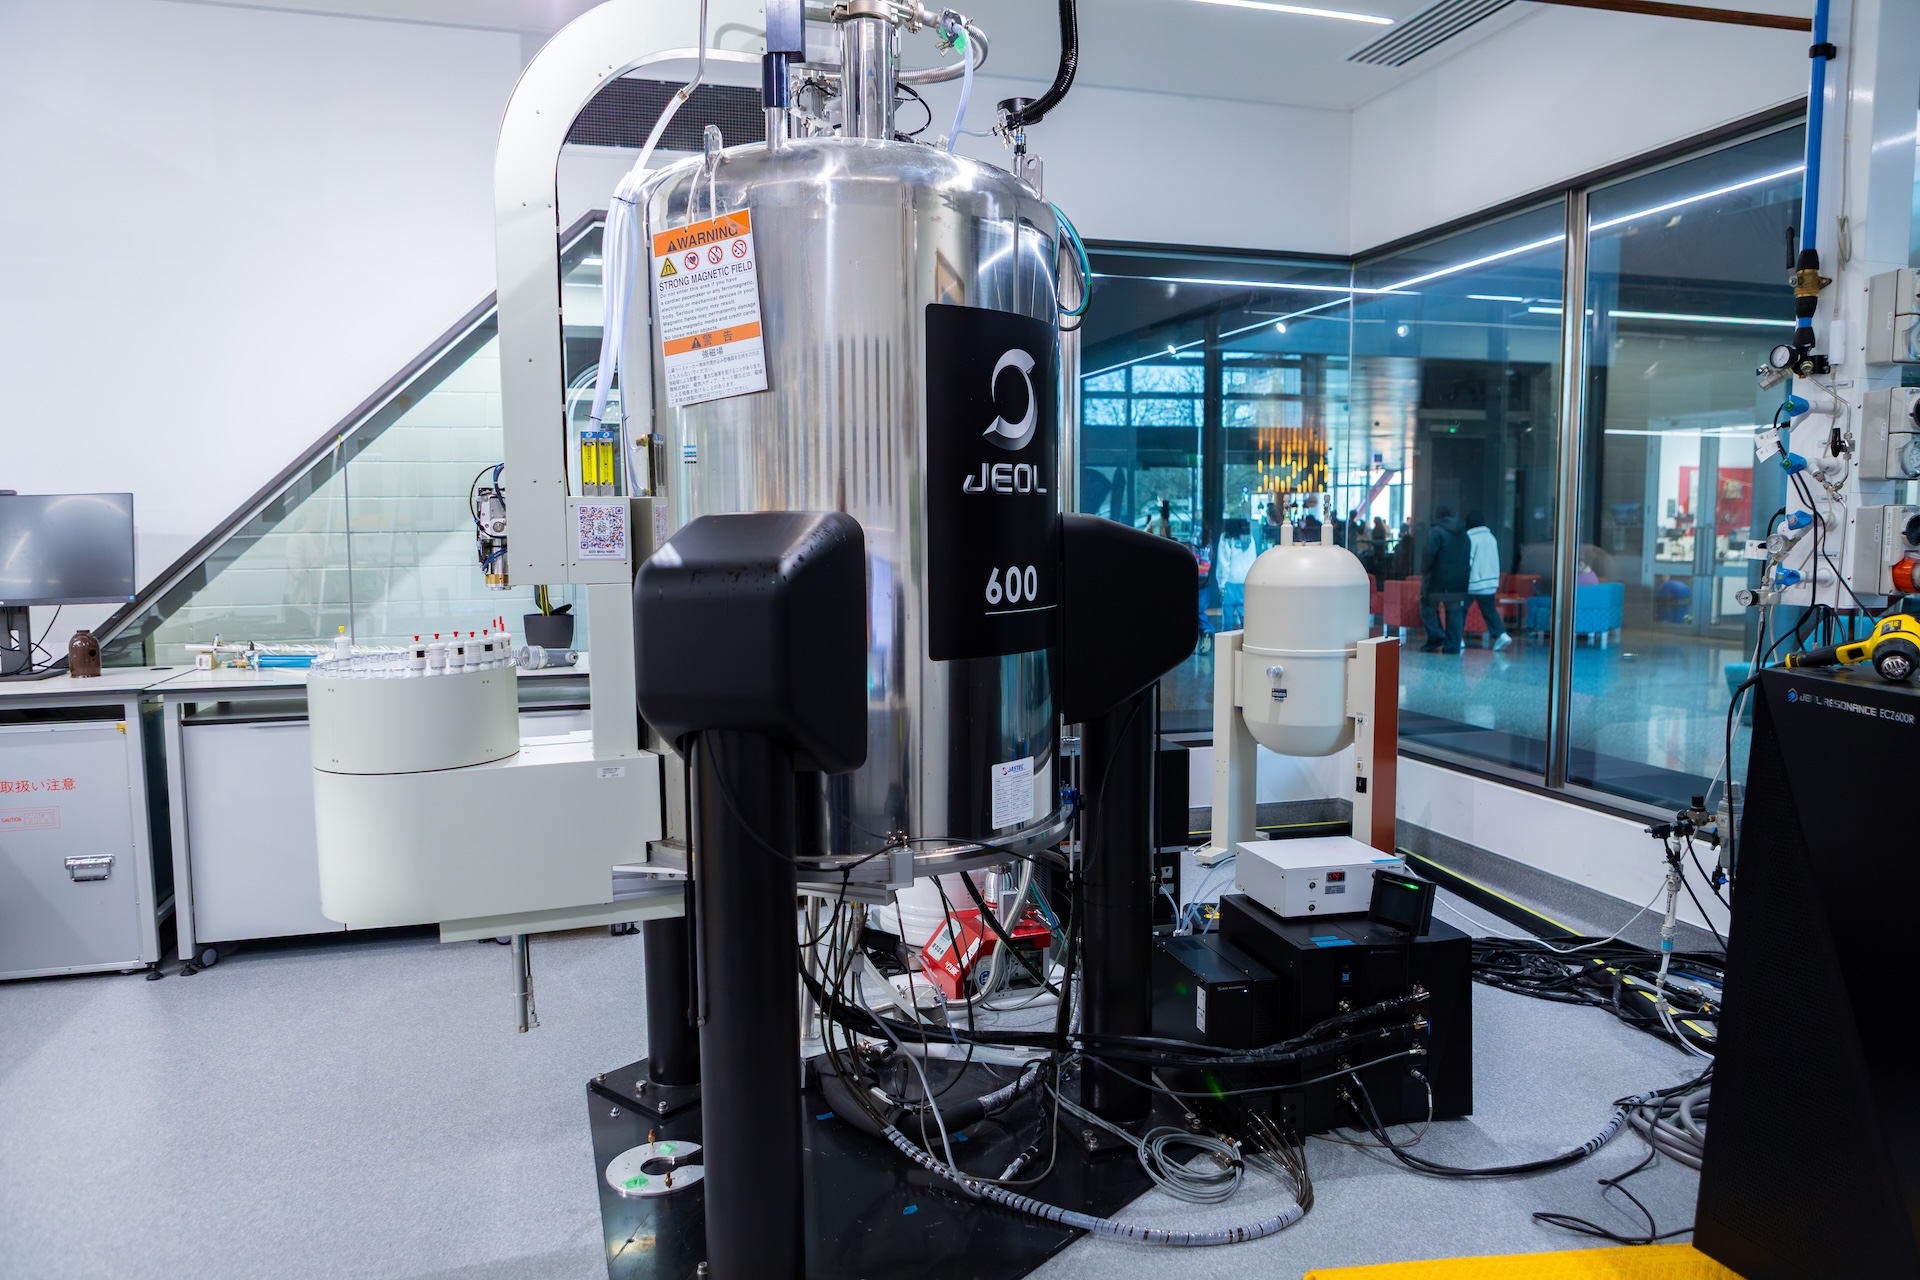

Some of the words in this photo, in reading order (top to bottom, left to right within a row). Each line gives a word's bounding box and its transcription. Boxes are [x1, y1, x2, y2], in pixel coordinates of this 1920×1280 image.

[677, 224, 738, 250] WARNING
[659, 277, 689, 291] STRONG
[692, 266, 729, 284] MAGNETIC
[732, 260, 752, 274] FIELD
[681, 291, 705, 301] pacemaker
[691, 295, 717, 305] mechanical
[718, 291, 736, 299] devices
[662, 318, 683, 327] Magnetic
[708, 305, 736, 317] permanently
[737, 301, 756, 310] damage
[675, 308, 693, 316] Serious
[694, 305, 708, 313] injury
[700, 325, 717, 334] objects.
[701, 346, 723, 358] 強磁場
[963, 463, 1047, 495] JEOL
[985, 565, 1038, 604] 600
[1799, 693, 1822, 705] JEL
[1823, 698, 1877, 716] RESONANCE
[1880, 708, 1915, 724] ECZ600R
[0, 778, 76, 793] 取扱い注意
